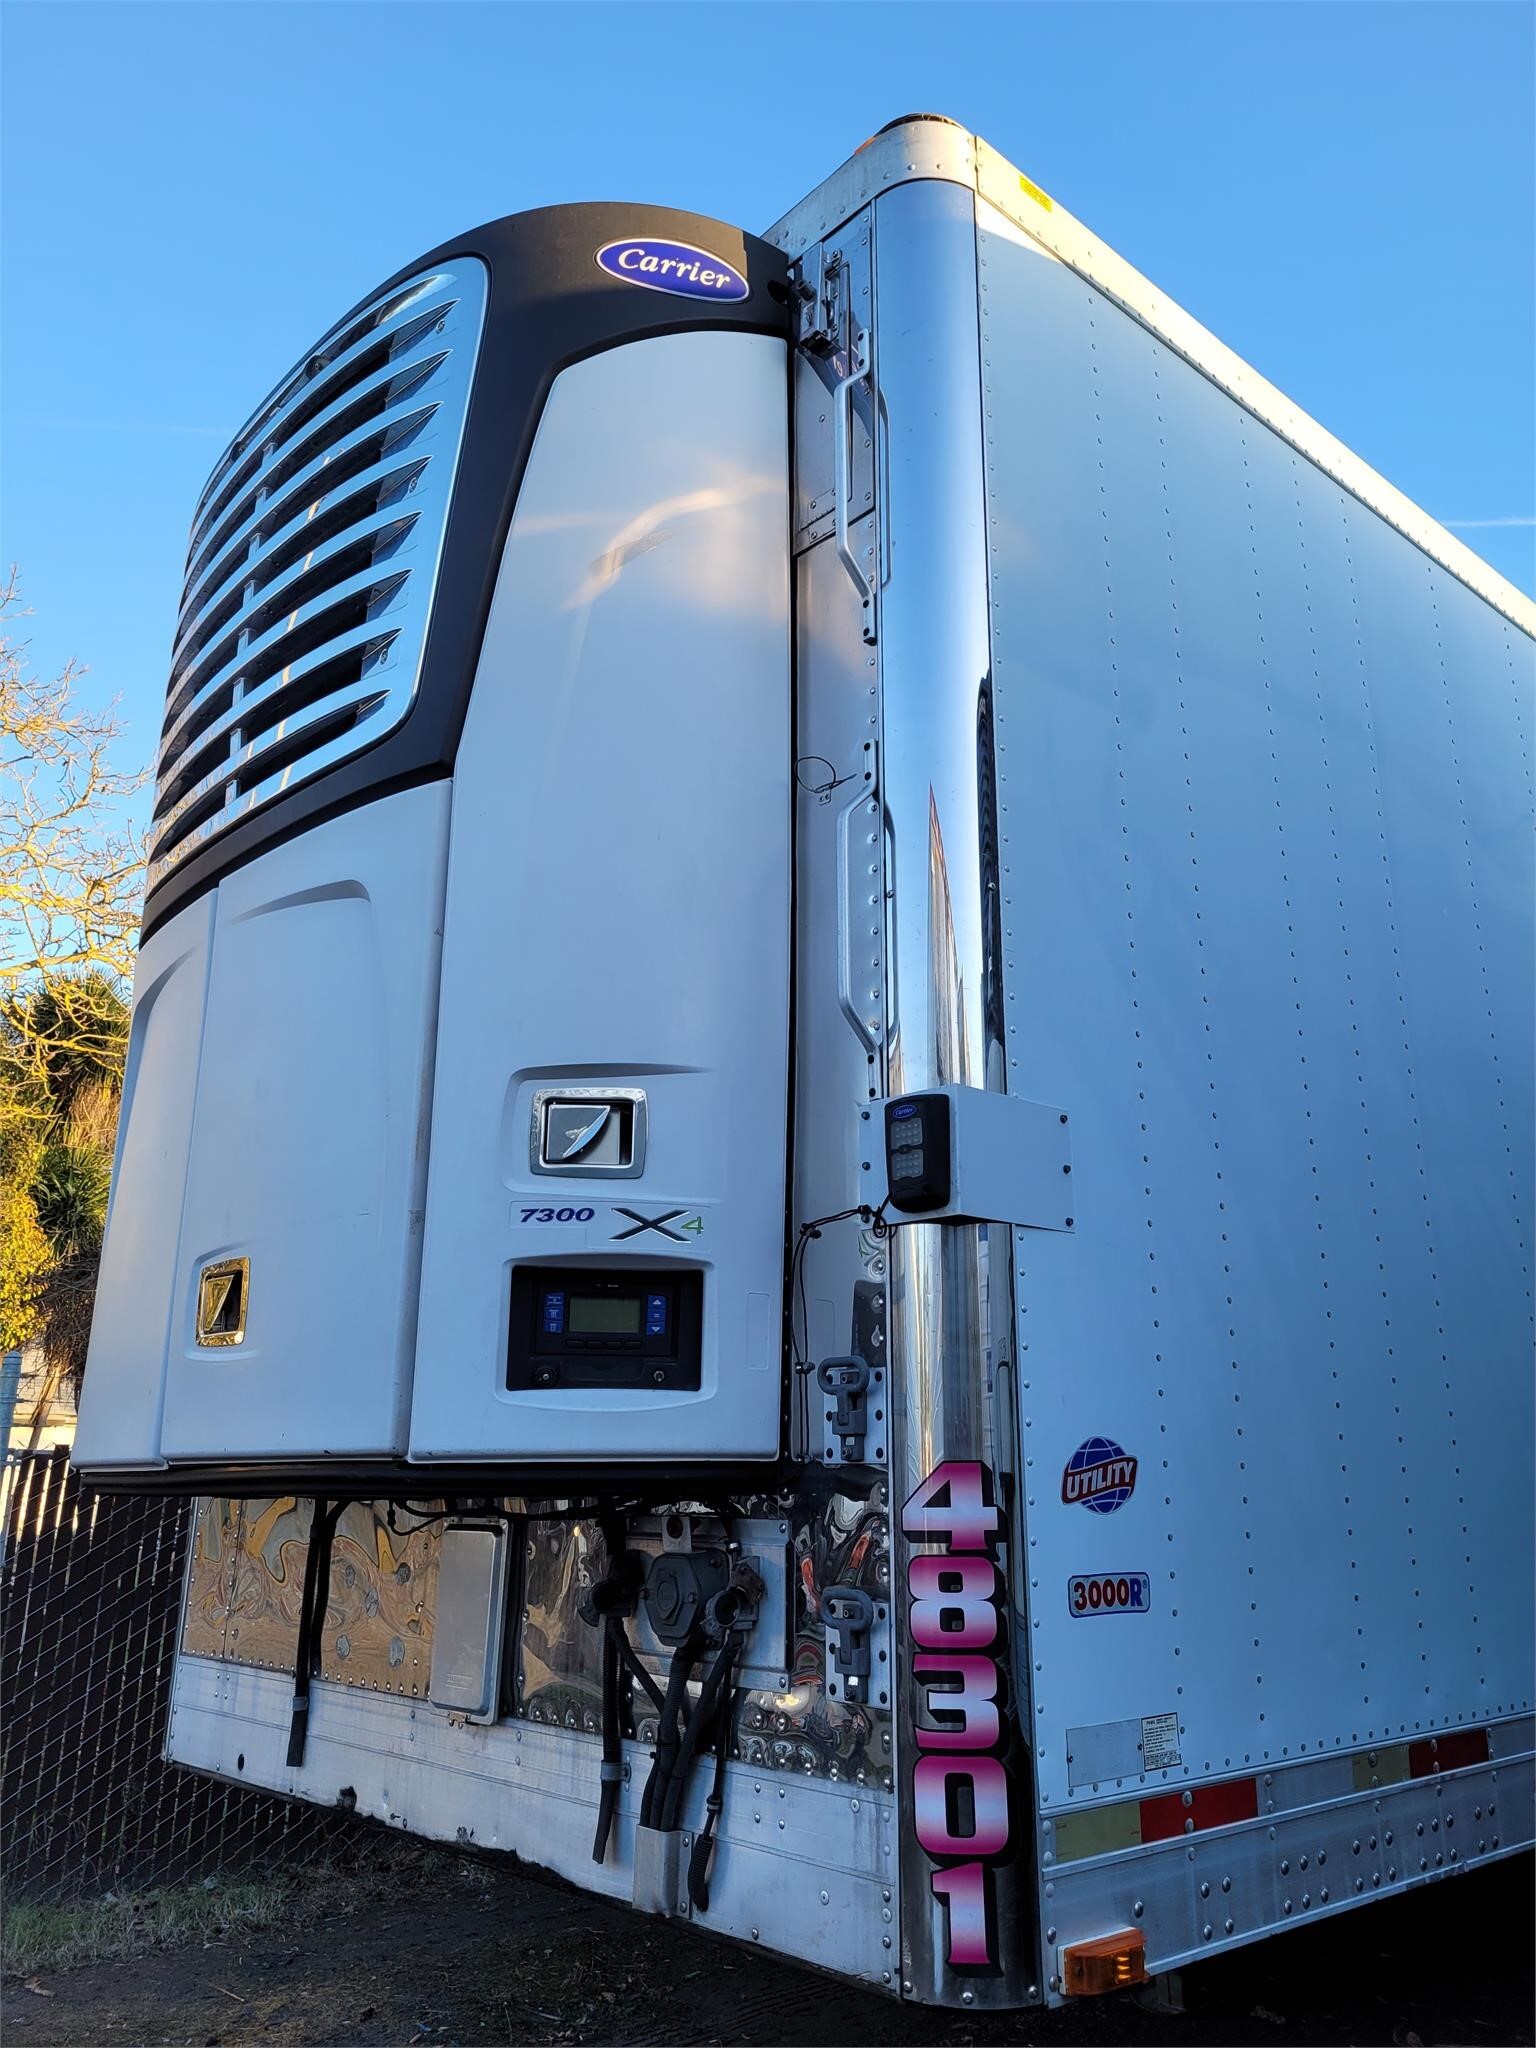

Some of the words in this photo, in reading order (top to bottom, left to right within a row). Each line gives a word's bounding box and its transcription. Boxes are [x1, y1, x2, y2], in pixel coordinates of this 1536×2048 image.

[618, 249, 731, 288] Carrier
[521, 1207, 595, 1223] 7300
[1066, 1461, 1134, 1499] UTILITY
[1073, 1577, 1143, 1610] 3000R
[902, 1460, 1011, 1970] 48301
